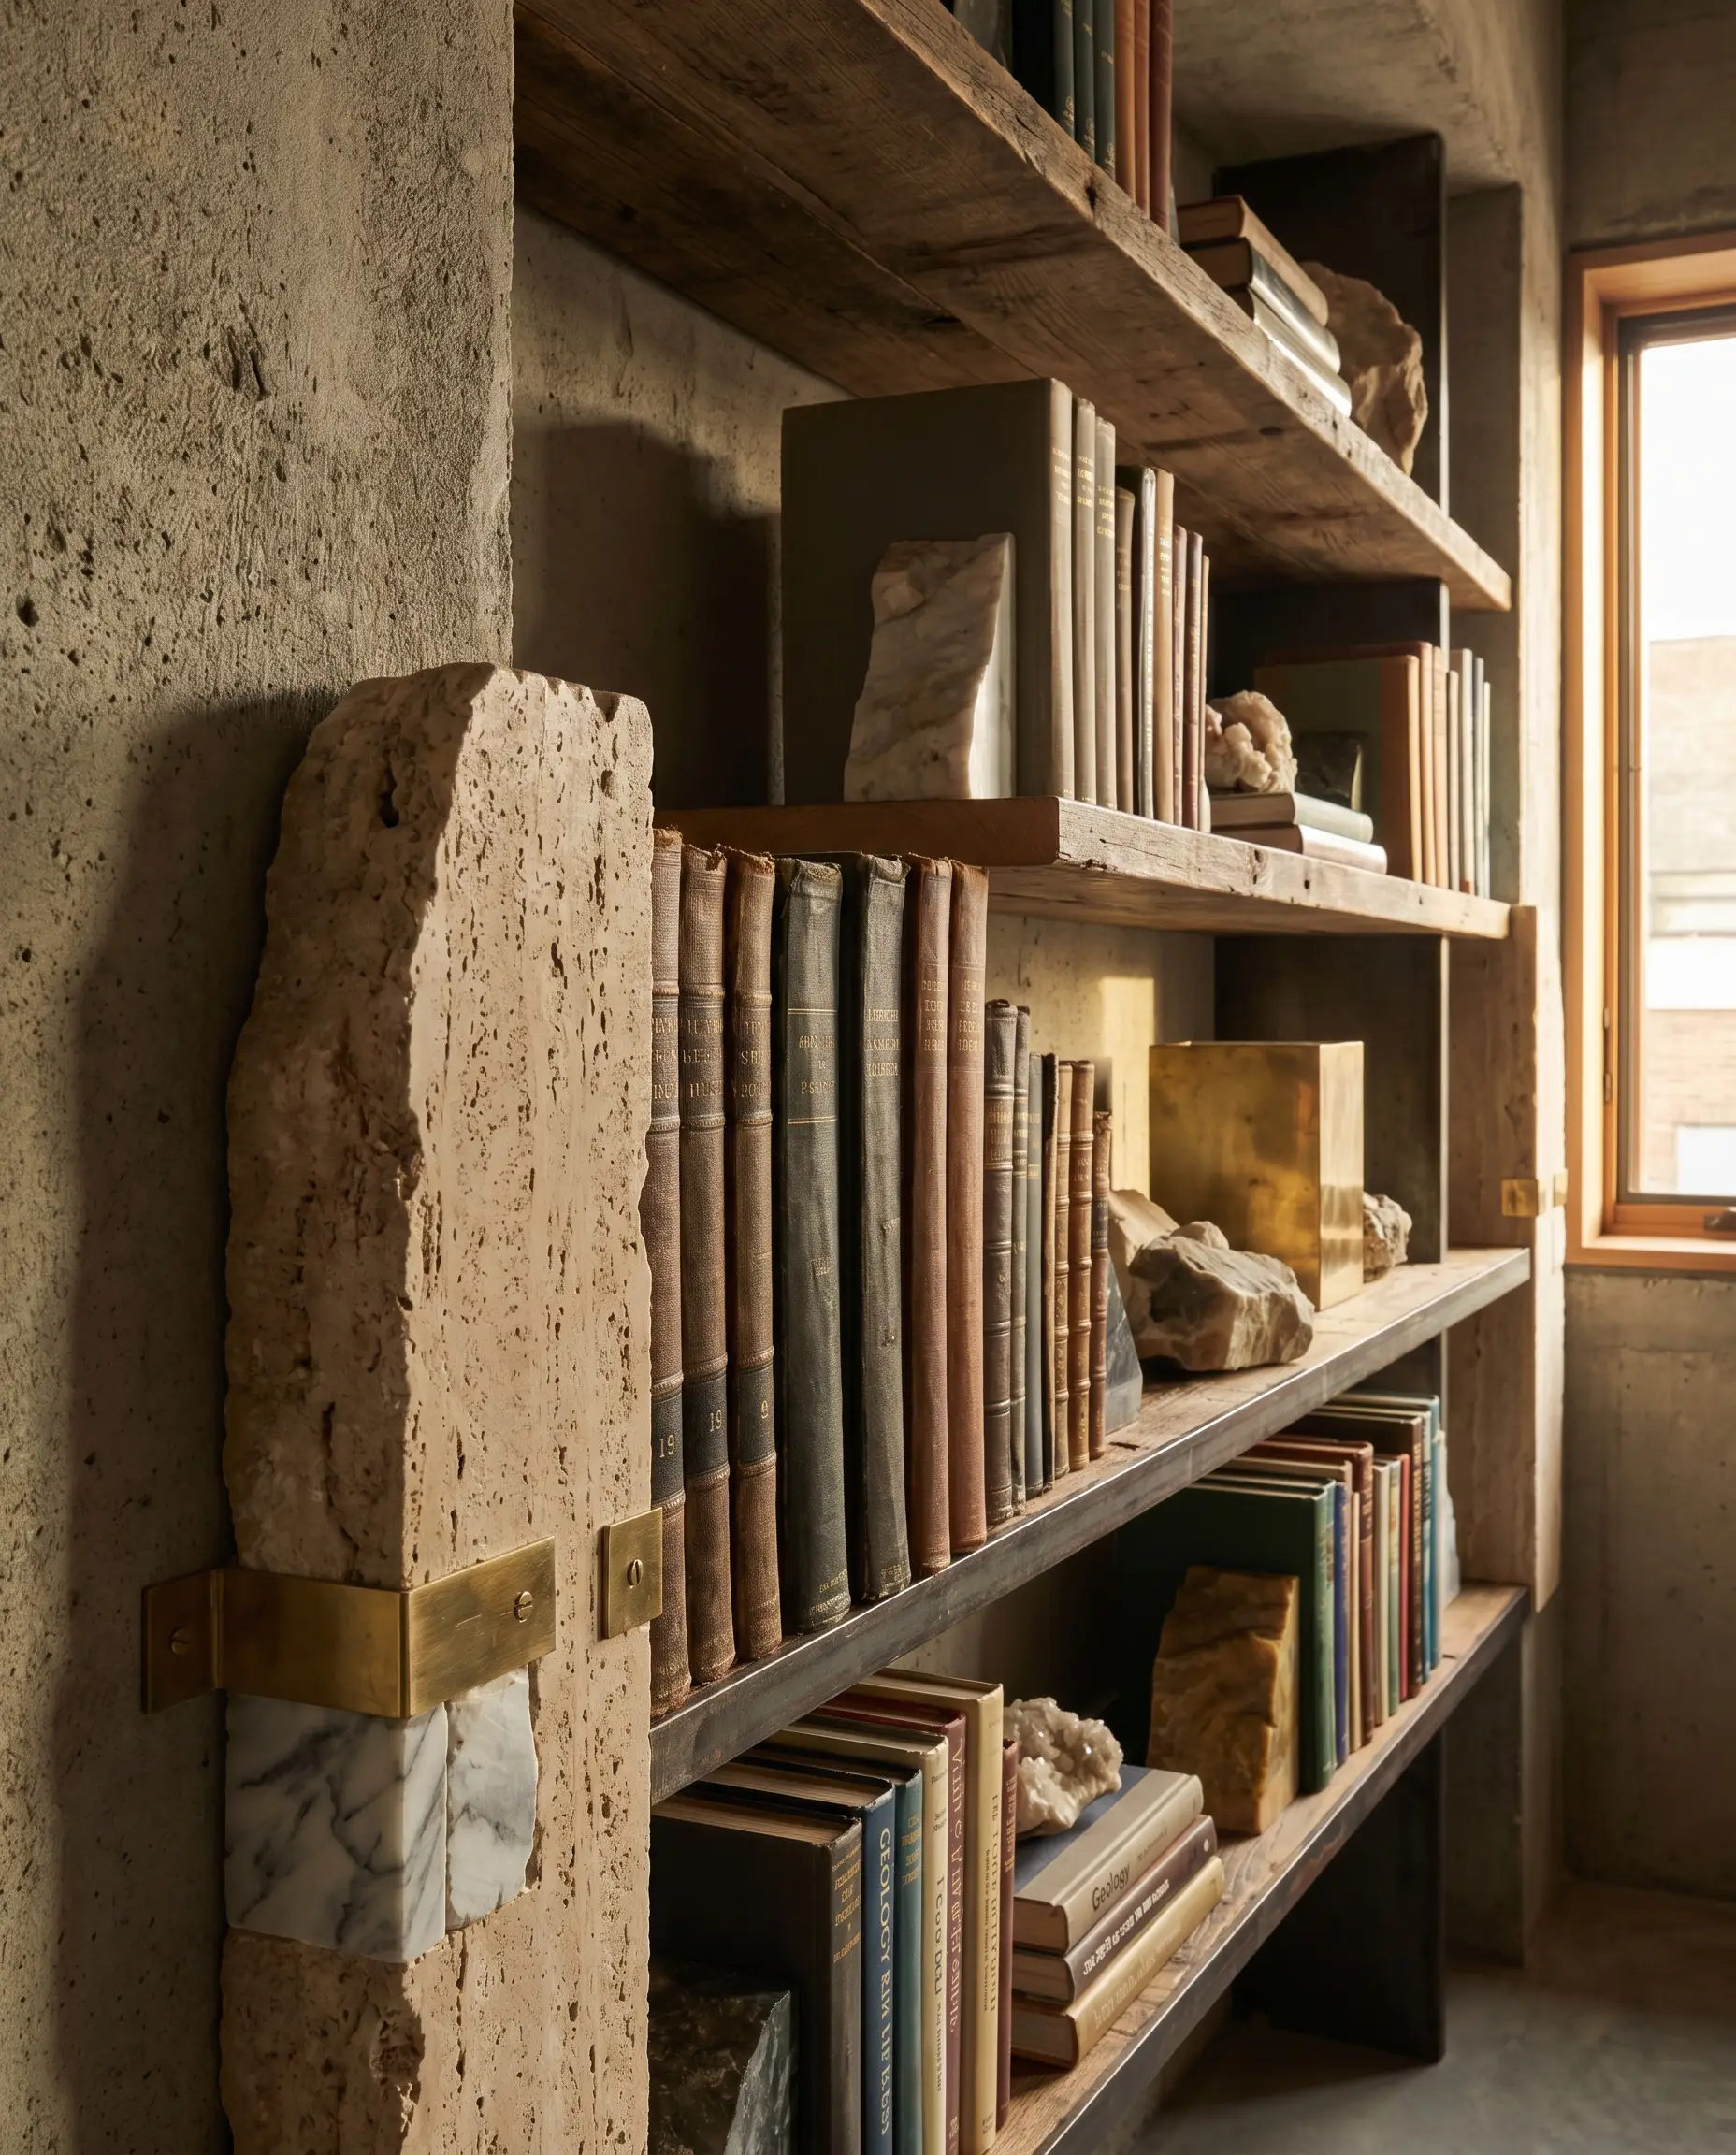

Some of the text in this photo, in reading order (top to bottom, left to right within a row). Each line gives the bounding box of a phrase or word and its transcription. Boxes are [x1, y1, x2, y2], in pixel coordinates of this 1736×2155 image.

[709, 1410, 722, 1432] 19
[659, 1434, 675, 1458] 19
[879, 1827, 890, 1962] GEOLOGY
[1092, 1863, 1130, 1911] Geology
